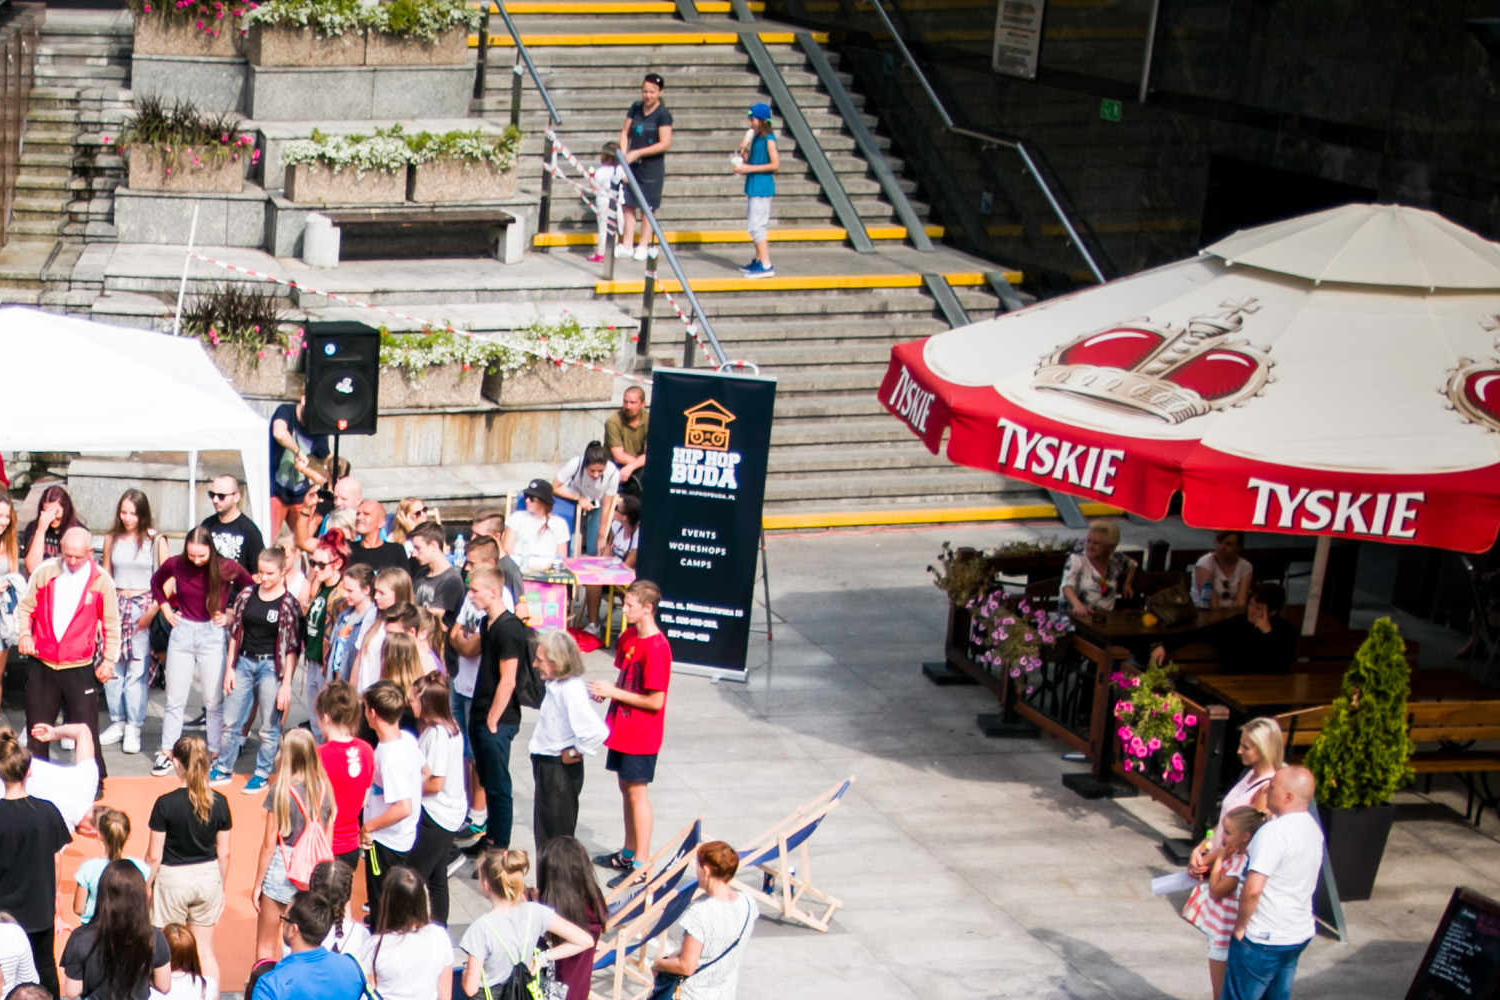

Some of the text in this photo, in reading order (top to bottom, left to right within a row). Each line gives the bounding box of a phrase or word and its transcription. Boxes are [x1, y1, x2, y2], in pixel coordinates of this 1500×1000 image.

[889, 364, 935, 434] TYSKIE
[672, 447, 741, 469] HIP HOP
[997, 417, 1126, 496] TYSKIE
[670, 463, 738, 490] BUDA
[1247, 477, 1426, 539] TYSKIE
[681, 528, 717, 540] EVENTS
[669, 541, 727, 556] WORKSHOPS
[680, 557, 712, 569] CAMPS
